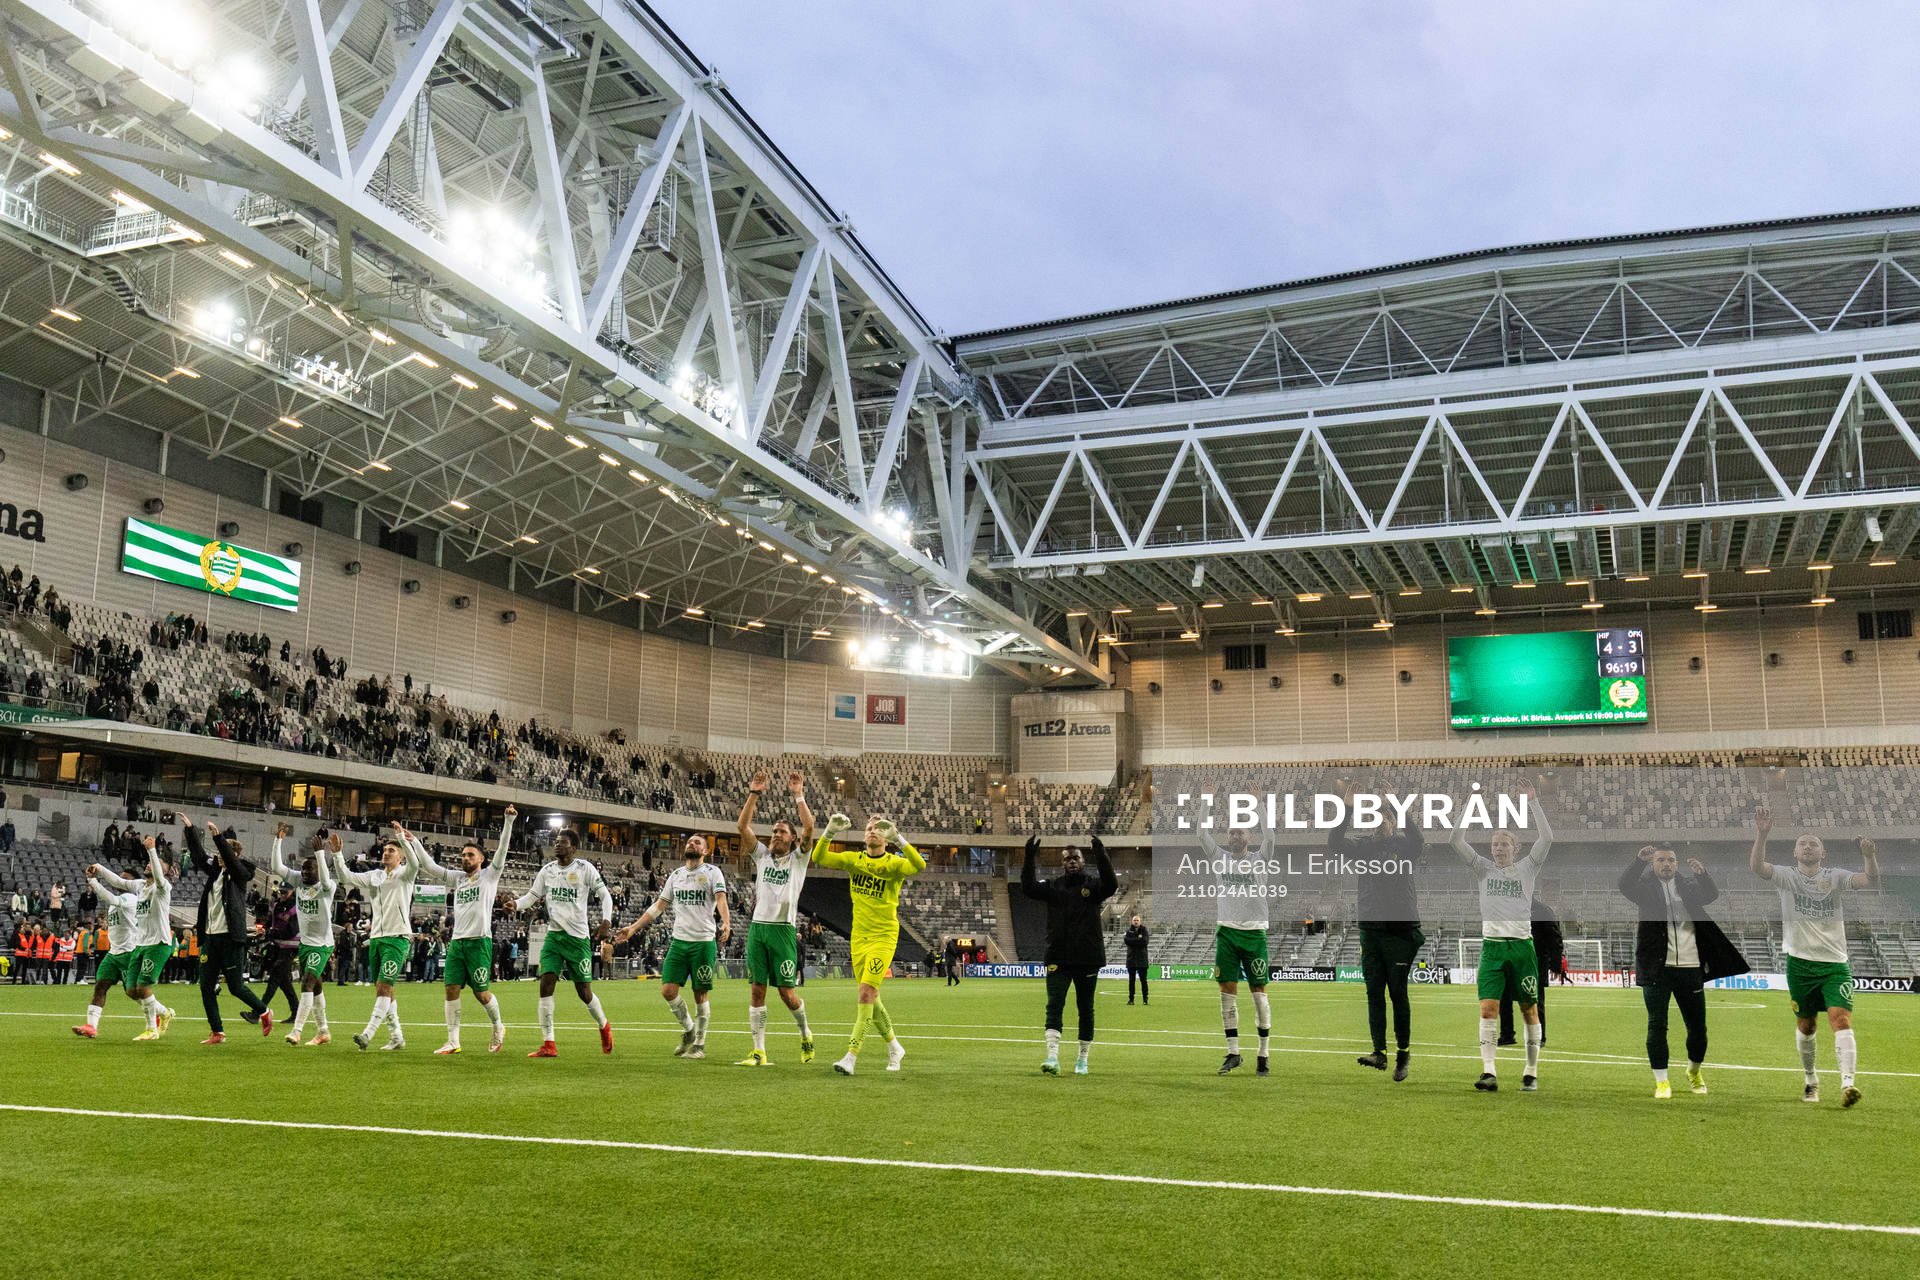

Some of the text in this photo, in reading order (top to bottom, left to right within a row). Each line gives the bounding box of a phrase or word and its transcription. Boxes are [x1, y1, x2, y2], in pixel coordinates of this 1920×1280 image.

[1603, 641, 1613, 654] 4
[1628, 640, 1637, 653] 3
[1606, 661, 1638, 673] 96:19
[875, 699, 895, 713] JOB
[873, 713, 898, 722] ZONE
[1024, 719, 1111, 737] TELE2 Arena
[852, 873, 886, 892] HUSKI
[976, 965, 992, 976] THE
[994, 965, 1032, 976] CENTRAL
[1272, 969, 1335, 981] glasmästeri
[1715, 975, 1768, 988] Flinks
